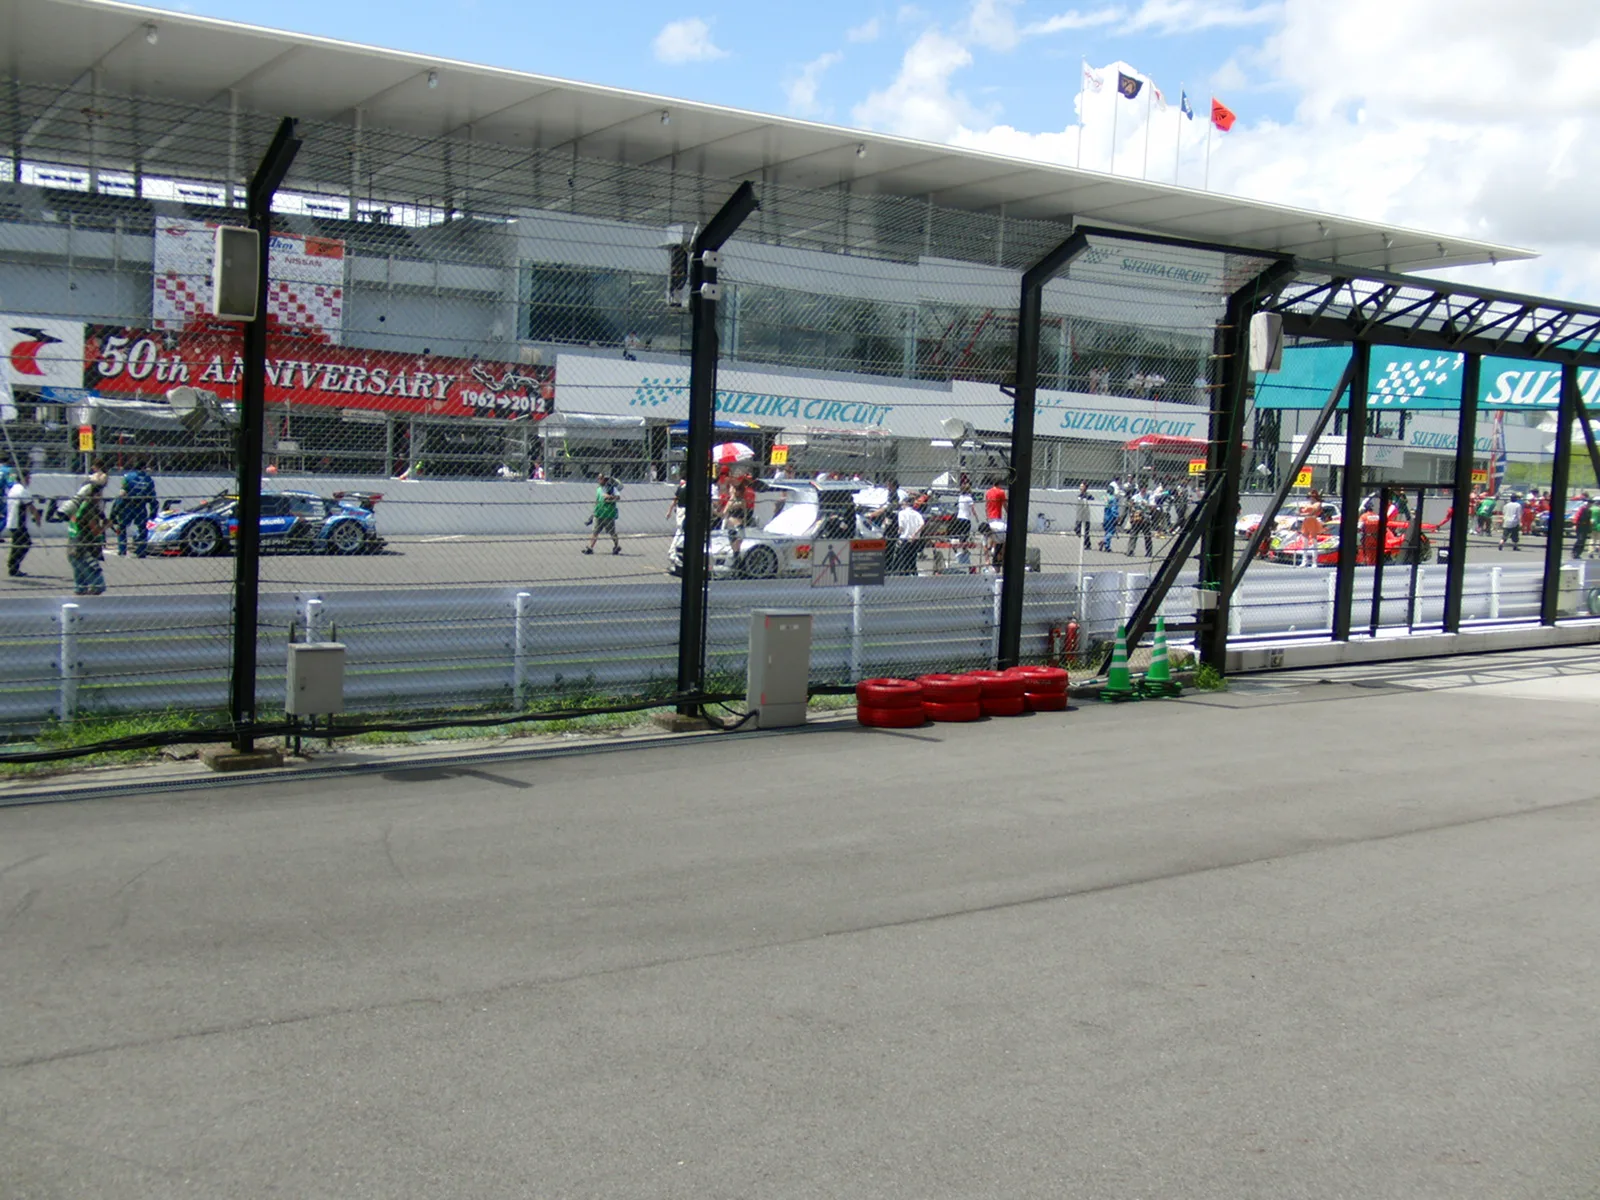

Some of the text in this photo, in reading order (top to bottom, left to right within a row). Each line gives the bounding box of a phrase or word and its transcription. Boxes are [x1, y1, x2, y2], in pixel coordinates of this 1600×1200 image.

[285, 257, 322, 267] NISSAN
[1120, 258, 1211, 284] SUZUKA CIRCUIT
[98, 336, 456, 400] 50th ANNIVERSARY
[461, 390, 546, 413] 1962 2012
[715, 391, 893, 425] SUZUKA CIRCUIT
[1060, 411, 1196, 437] SUZUKA CIRCUIT
[1410, 431, 1457, 449] SUZUKA
